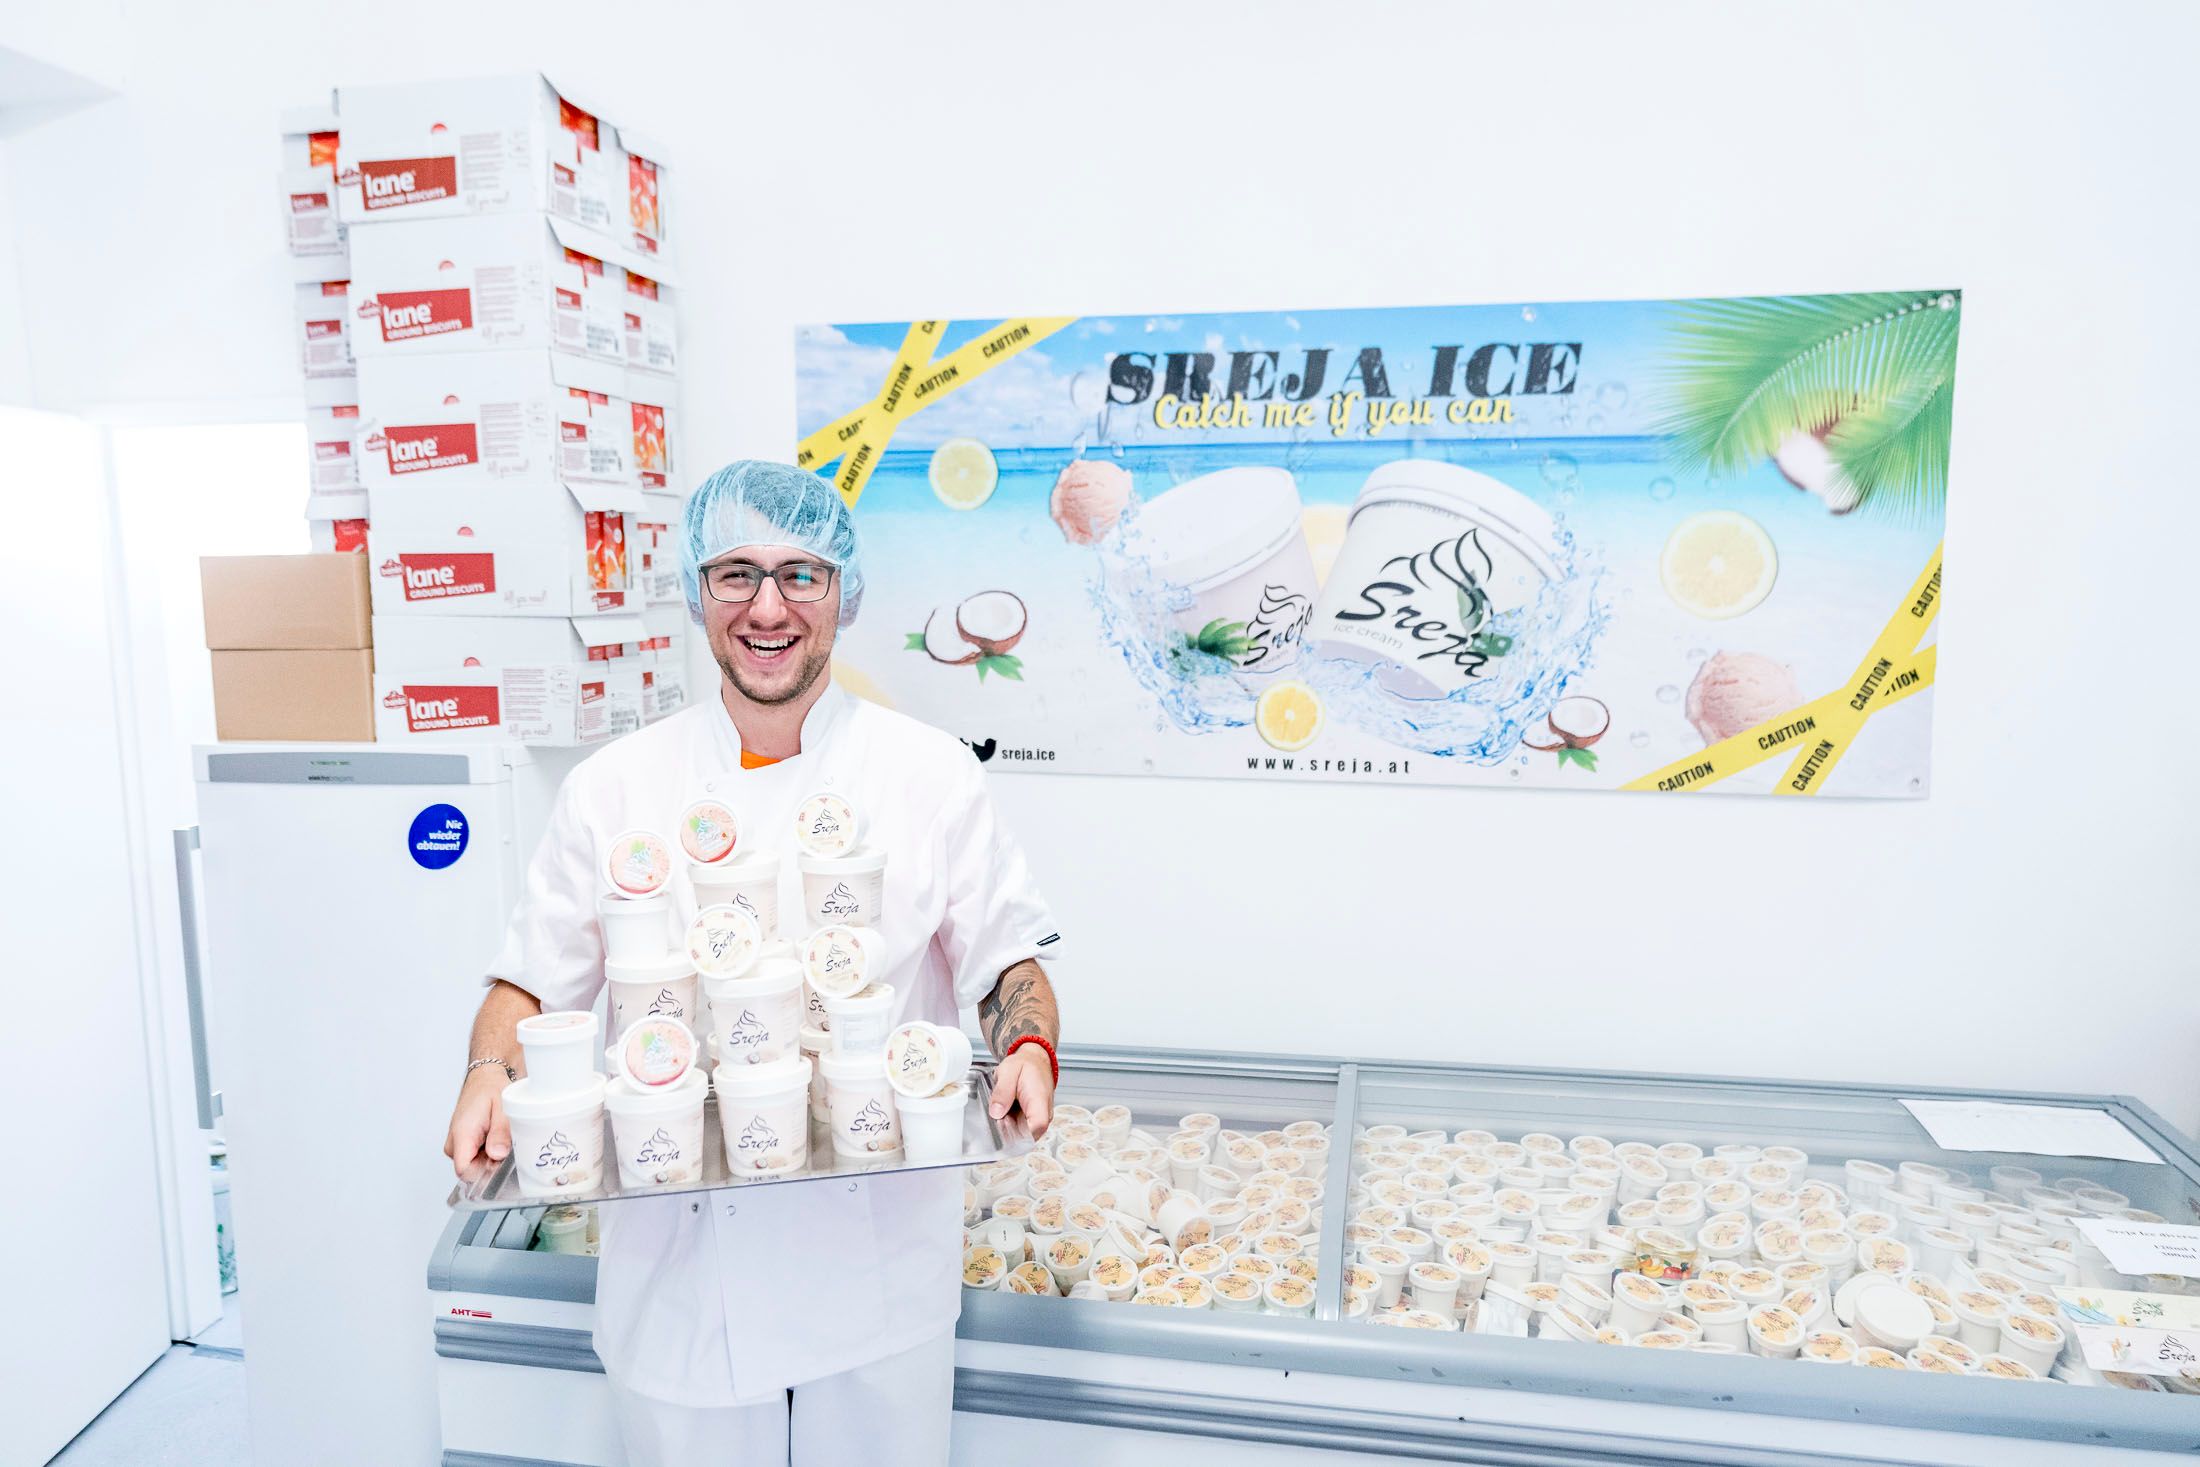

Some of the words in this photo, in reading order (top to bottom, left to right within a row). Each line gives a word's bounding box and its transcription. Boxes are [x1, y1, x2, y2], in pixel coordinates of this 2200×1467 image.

[364, 170, 416, 198] lane
[383, 302, 433, 329] lane
[981, 324, 1031, 358] CAUTION
[914, 366, 959, 399] CAUTION
[1106, 346, 1396, 405] SREJA
[1424, 343, 1583, 398] ICE
[882, 363, 913, 413] CAUTION
[1153, 391, 1253, 430] Catch
[1263, 403, 1317, 428] me
[1328, 391, 1364, 437] if
[1367, 397, 1434, 437] you
[1446, 398, 1516, 425] can
[390, 438, 438, 462] lane
[430, 453, 469, 468] BISCUITS
[841, 443, 873, 492] CAUTION
[405, 565, 456, 590] lane
[409, 588, 447, 599] GROUND
[447, 583, 486, 597] BISCUITS
[1333, 623, 1352, 634] ice
[1356, 627, 1404, 650] cream
[1335, 581, 1493, 678] Sreja
[1850, 657, 1893, 711] CAUTION
[408, 697, 459, 721] lane
[412, 718, 449, 731] GROUND
[449, 715, 490, 729] BISCUITS
[1757, 707, 1817, 750] CAUTION
[1001, 748, 1055, 761] sreja.ice
[1247, 757, 1410, 774] www.sreja.at
[1791, 739, 1835, 792] CAUTION
[1657, 761, 1714, 792] CAUTION
[445, 819, 464, 830] Nie
[812, 822, 841, 835] Sreja
[428, 830, 462, 841] wieder
[416, 840, 461, 851] abtauen!
[821, 899, 860, 918] Sreja
[825, 957, 851, 973] Sreja
[729, 1030, 769, 1048] Sreja
[850, 1118, 891, 1136] Sreja
[738, 1134, 780, 1153] Sreja
[535, 1151, 580, 1168] Sreja
[636, 1148, 681, 1166] Sreja
[451, 1307, 472, 1317] AHT
[2158, 1349, 2197, 1366] Sreja
